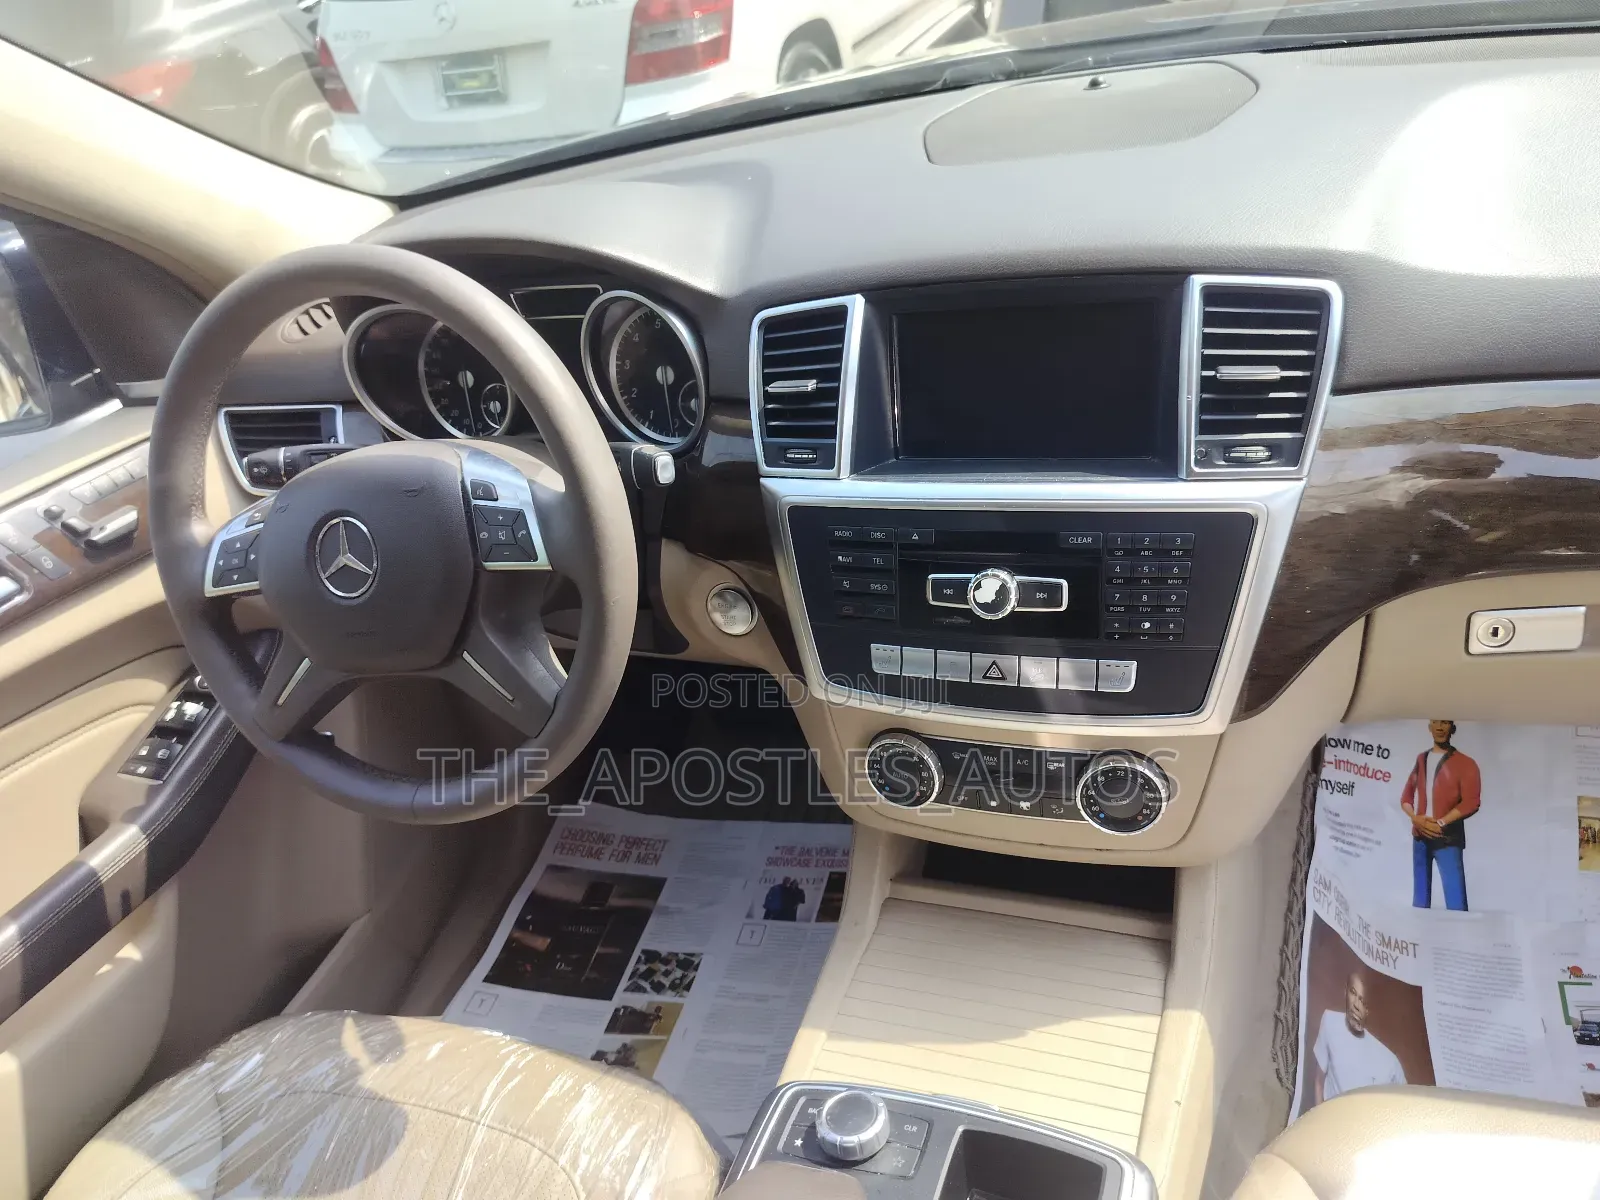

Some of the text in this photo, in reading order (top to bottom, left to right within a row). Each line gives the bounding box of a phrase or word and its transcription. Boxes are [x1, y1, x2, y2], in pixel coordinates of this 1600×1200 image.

[655, 319, 661, 328] 5
[633, 333, 639, 342] 4
[624, 360, 630, 369] 3
[631, 388, 638, 398] 2
[450, 409, 459, 417] 20
[649, 410, 654, 419] 1
[834, 530, 853, 538] RADIO
[870, 531, 886, 539] DISC
[1068, 536, 1093, 544] CLEAR
[1144, 537, 1150, 545] 2
[1175, 537, 1181, 545] 3
[872, 557, 884, 565] TEL
[1114, 565, 1121, 573] 4
[1143, 565, 1149, 573] 5
[1173, 566, 1179, 574] 6
[1114, 593, 1120, 601] 7
[1142, 594, 1148, 602] 8
[1170, 594, 1177, 602] 9
[1324, 736, 1391, 760] low me to
[1321, 754, 1392, 783] e-introduce
[560, 825, 671, 852] CHOOSING PERFECT
[552, 840, 662, 867] PERFUME FOR MEN
[765, 856, 812, 868] SHOWCASE
[1312, 886, 1333, 915] CITY
[1357, 914, 1372, 940] THE
[1375, 930, 1420, 959] SMART
[903, 1124, 918, 1133] CLR
